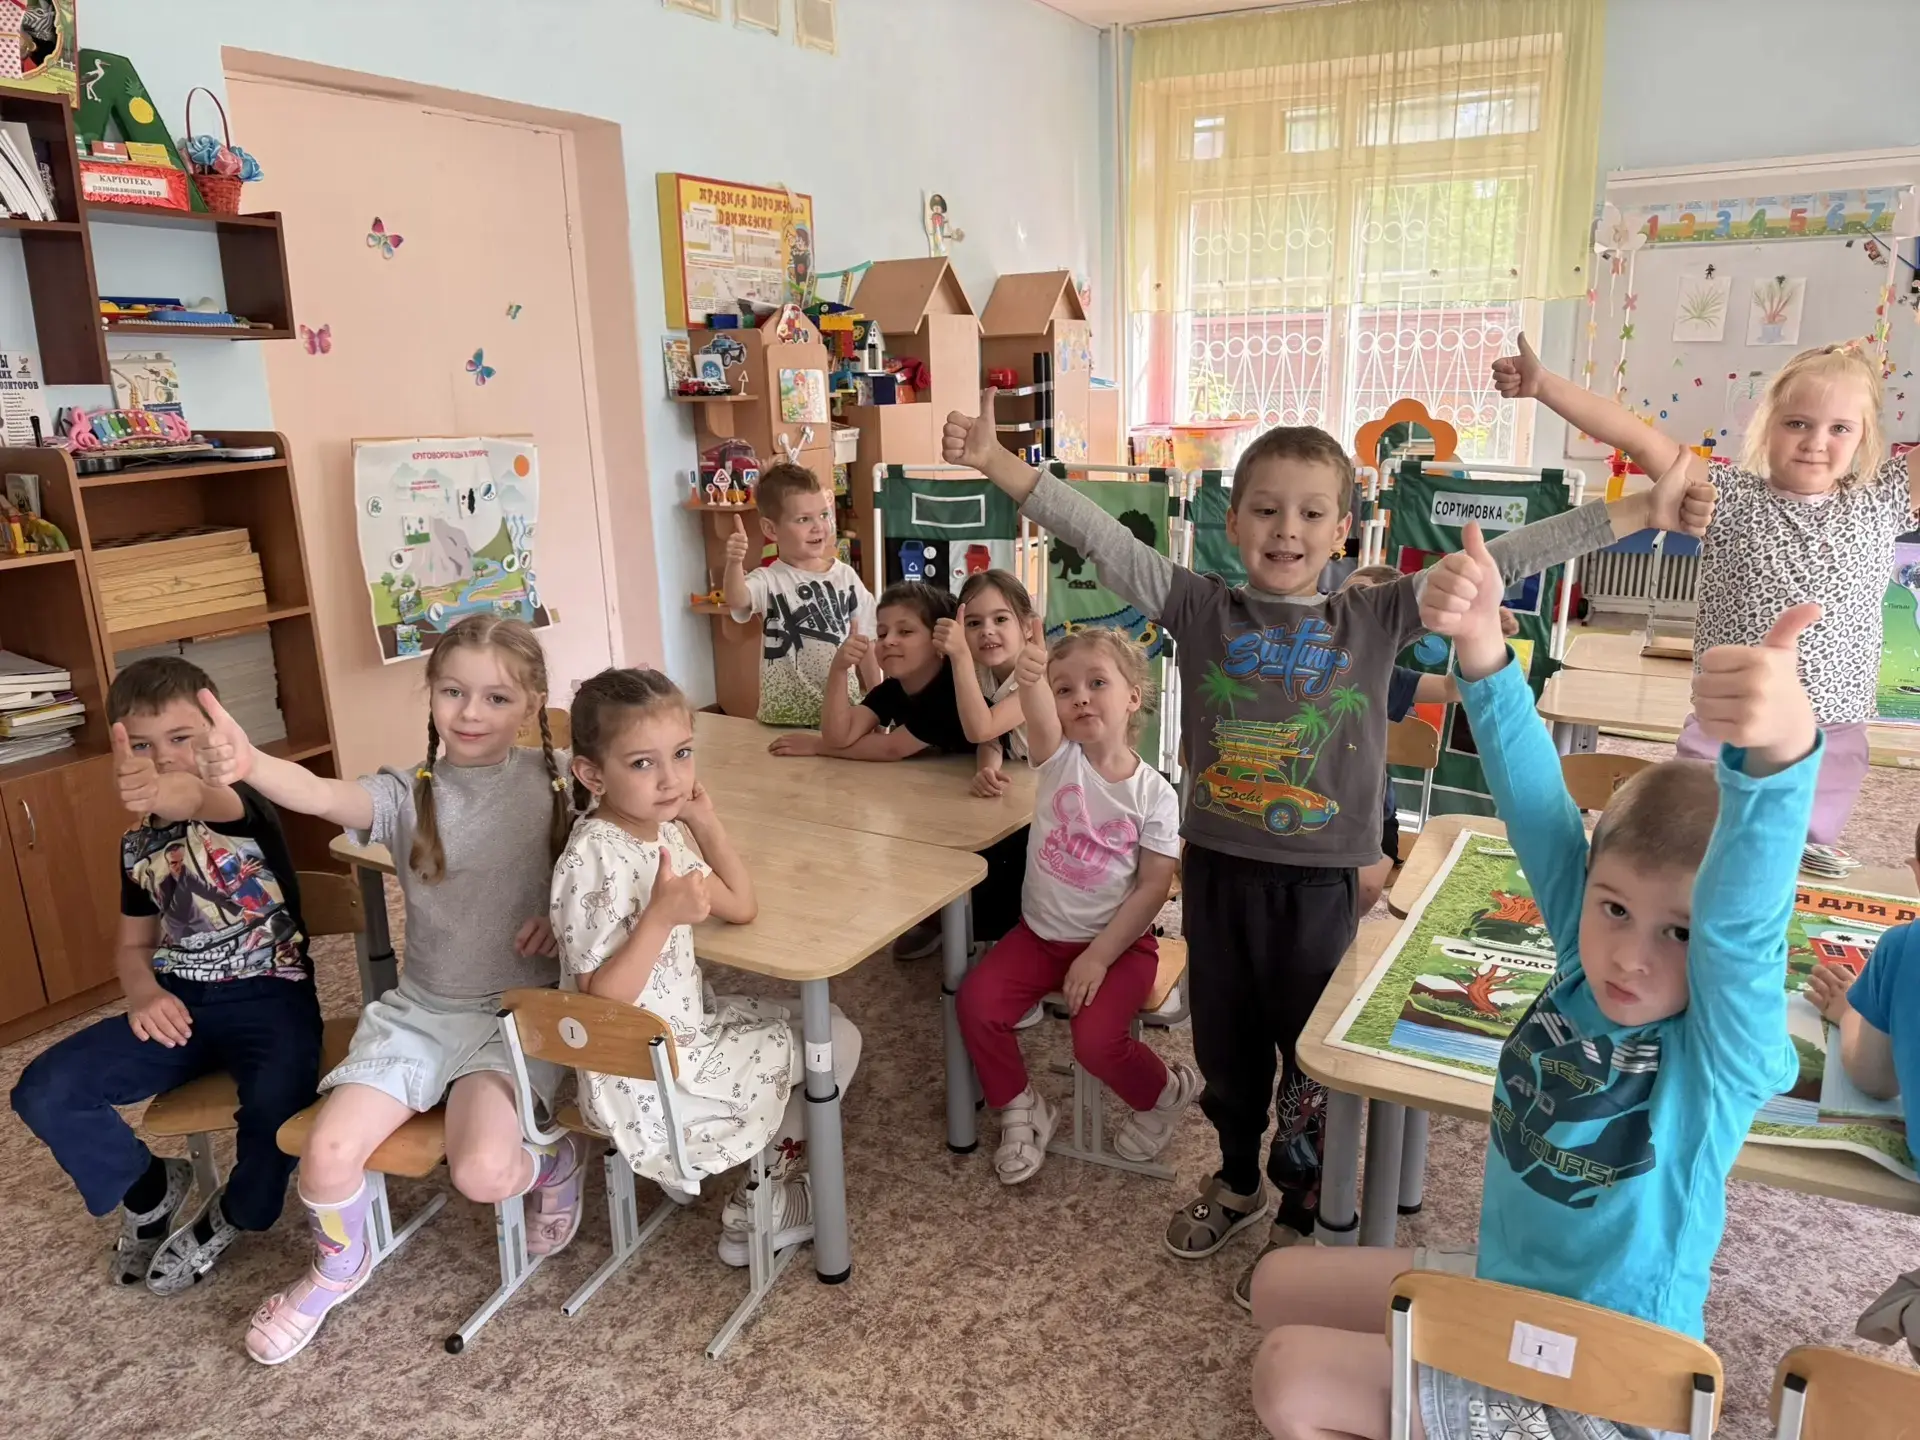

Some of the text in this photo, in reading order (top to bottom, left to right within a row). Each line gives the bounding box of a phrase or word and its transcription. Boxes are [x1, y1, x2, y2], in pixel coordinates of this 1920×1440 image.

[99, 174, 153, 186] КАРТОТЕКА
[1647, 214, 1659, 241] 1
[1679, 212, 1695, 237] 2
[1715, 210, 1732, 237] 3
[1789, 208, 1808, 233] 5
[1826, 202, 1845, 231] 6
[1864, 202, 1886, 229] 7
[1435, 500, 1503, 520] СОРТИРОВКА
[1217, 785, 1263, 803] Sochi
[1818, 897, 1886, 915] ДЛЯ
[1500, 956, 1557, 970] ВОДО
